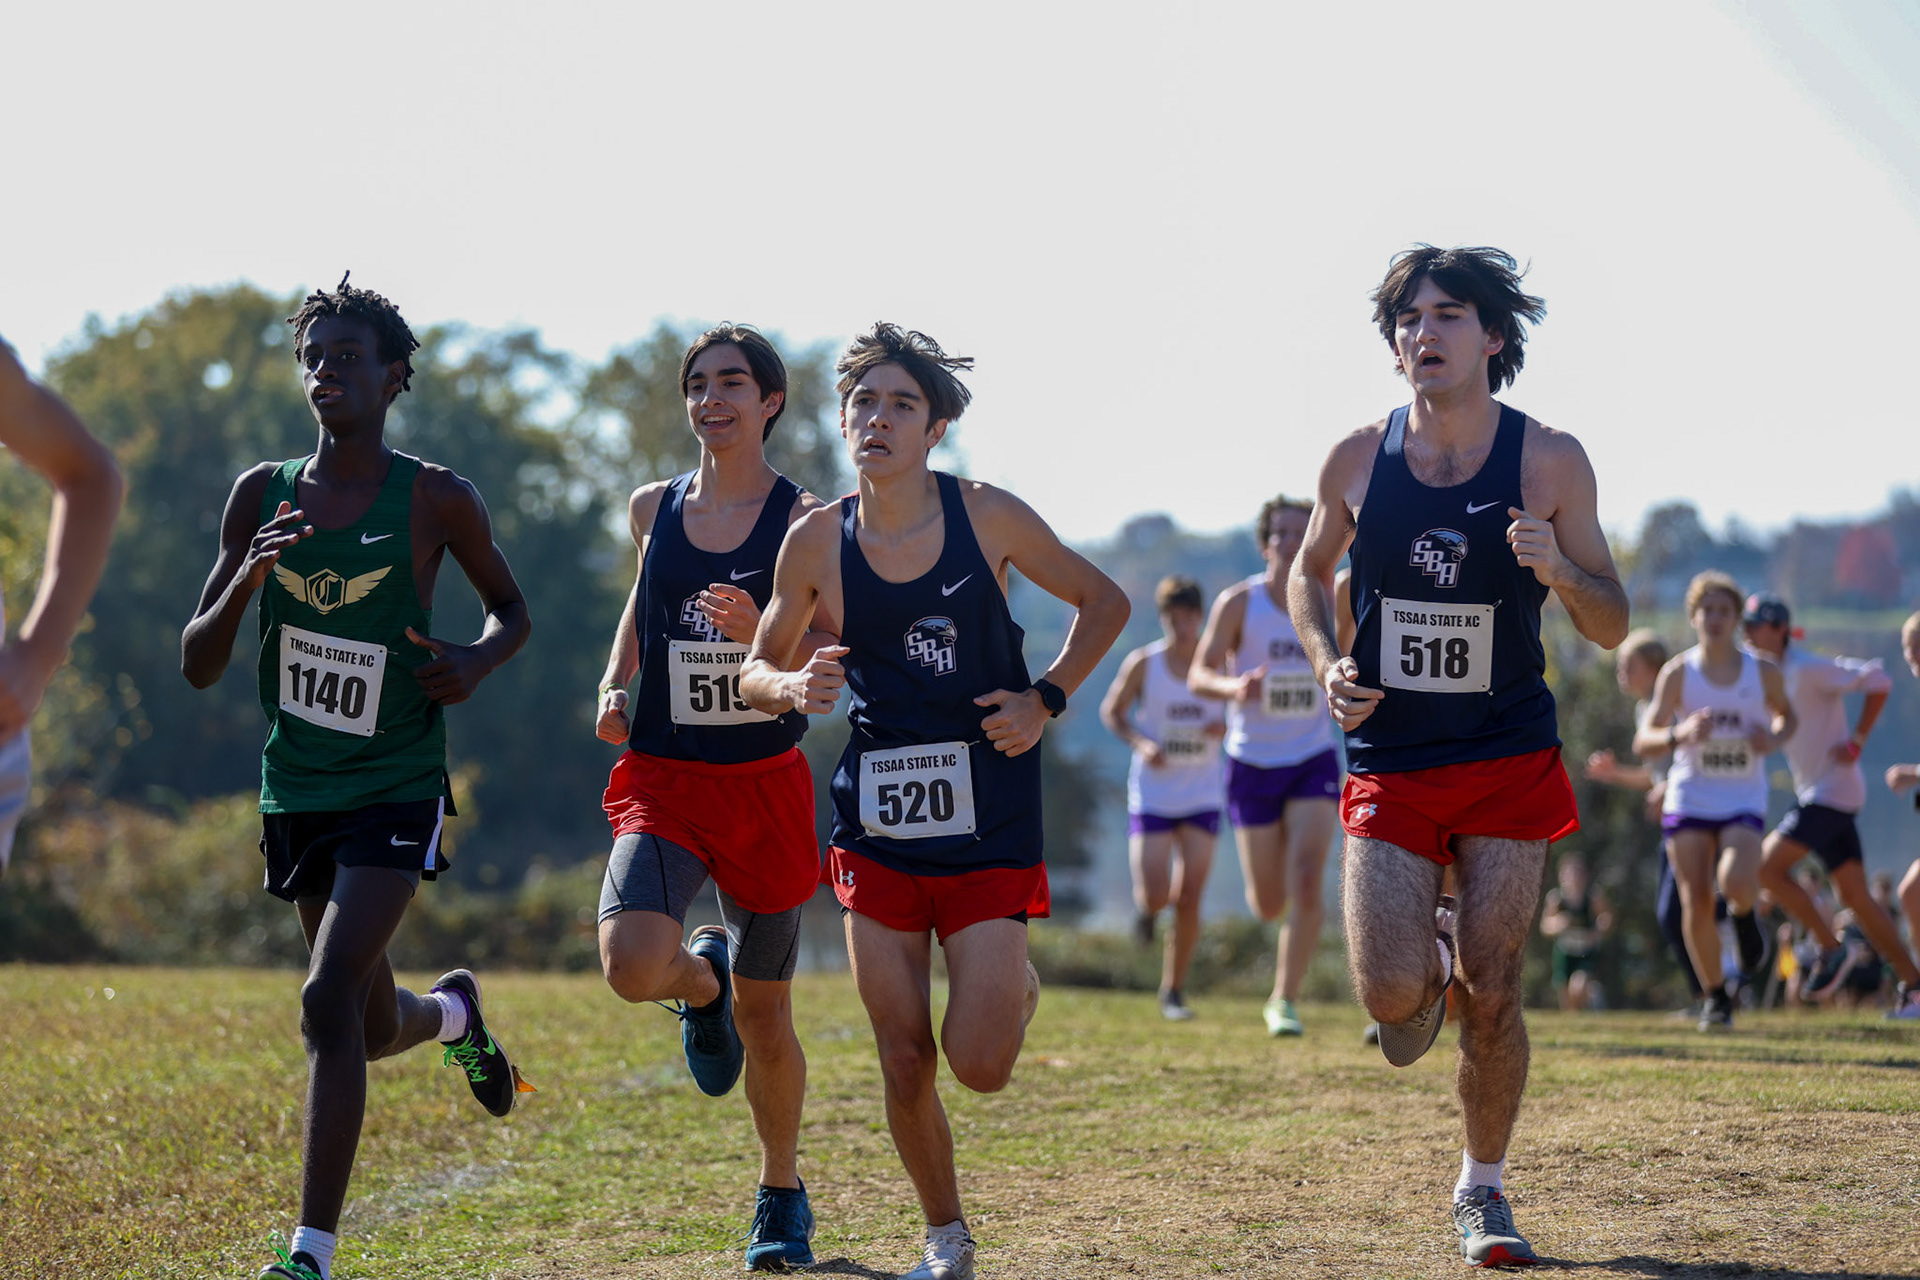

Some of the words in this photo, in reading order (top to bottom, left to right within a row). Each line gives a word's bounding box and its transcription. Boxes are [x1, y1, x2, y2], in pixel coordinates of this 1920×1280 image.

[1413, 541, 1457, 585] SBA
[1393, 610, 1427, 626] TSSAA
[1430, 614, 1462, 627] STATE
[1465, 615, 1480, 628] XC
[290, 637, 323, 659] TMSAA
[325, 647, 357, 665] STATE
[359, 653, 375, 668] XC
[680, 652, 713, 664] TSSAA
[907, 632, 954, 673] SBA
[1401, 635, 1469, 679] 518
[288, 662, 367, 719] 1140
[871, 756, 905, 774] TSSAA
[907, 755, 939, 770] STATE
[942, 753, 957, 767] XC
[878, 778, 954, 826] 520
